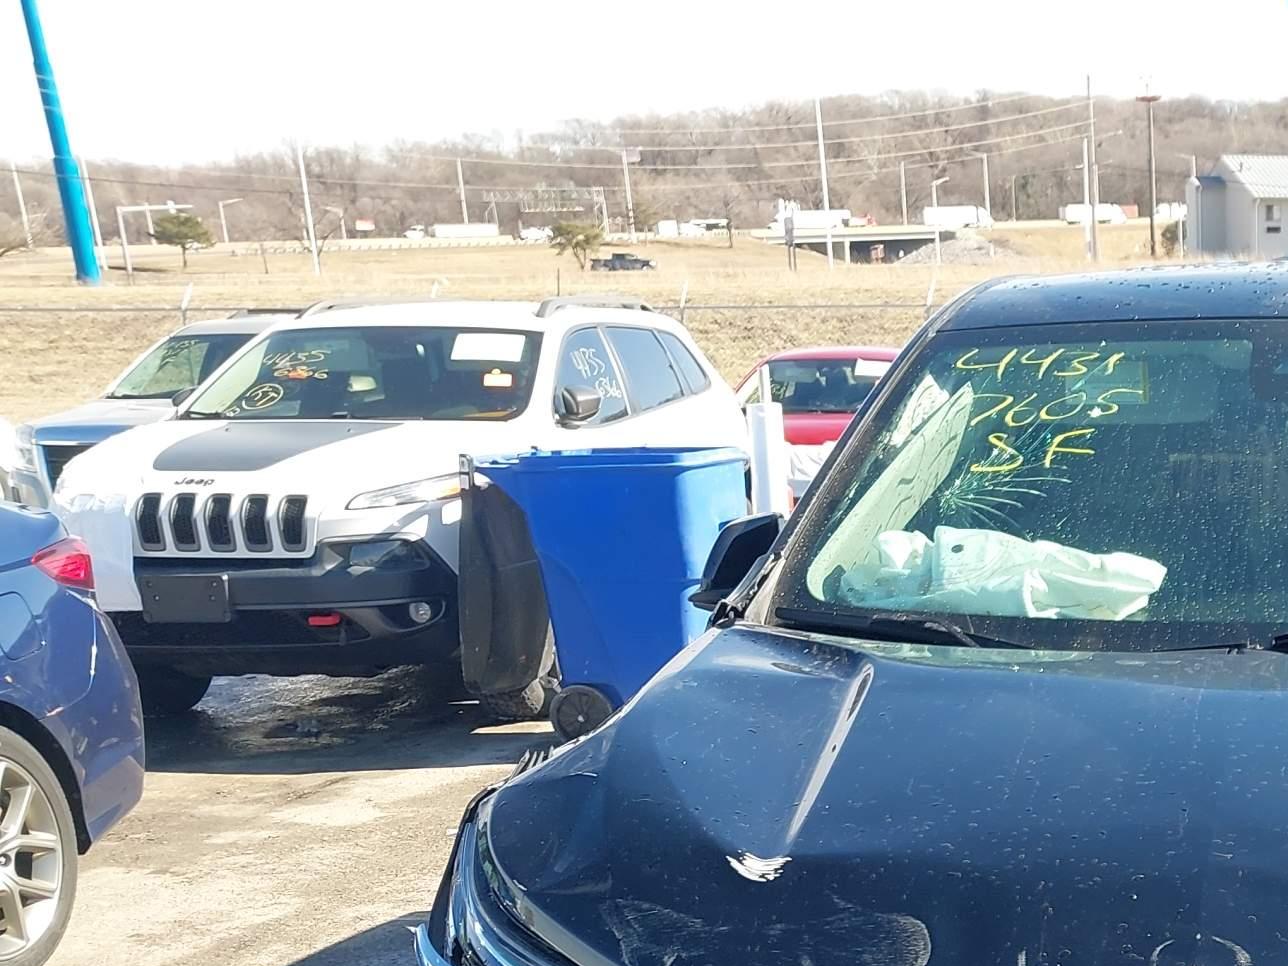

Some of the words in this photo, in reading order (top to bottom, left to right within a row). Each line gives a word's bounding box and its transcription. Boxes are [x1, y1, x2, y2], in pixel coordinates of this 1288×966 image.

[956, 348, 1125, 382] 4431
[969, 388, 1144, 428] 7605
[174, 476, 215, 487] Jeep
